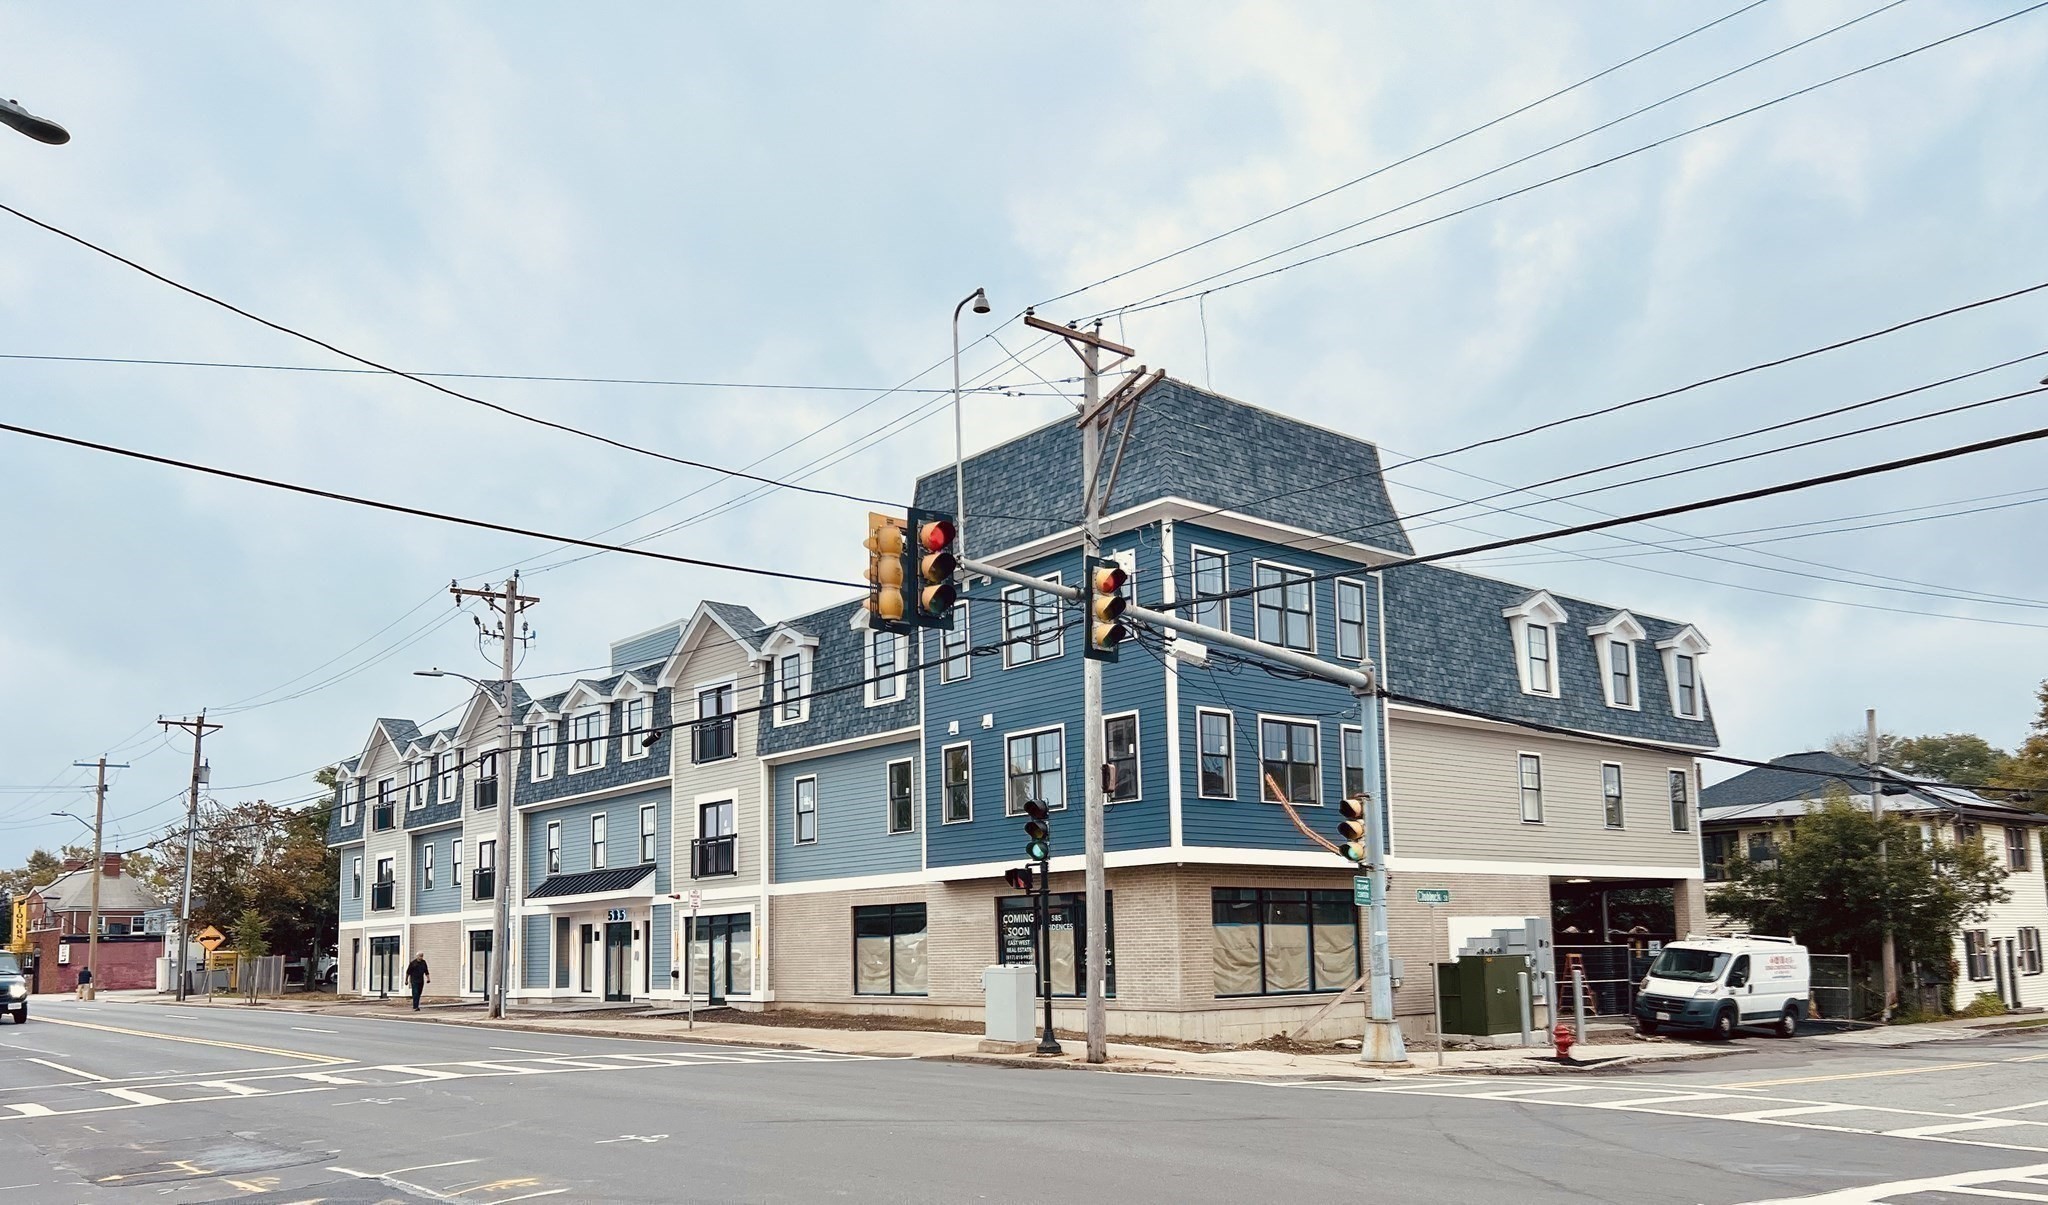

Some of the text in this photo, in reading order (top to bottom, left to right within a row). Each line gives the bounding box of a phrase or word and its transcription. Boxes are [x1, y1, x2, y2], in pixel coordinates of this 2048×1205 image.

[608, 909, 626, 922] 585
[1003, 913, 1034, 924] COMING
[1007, 926, 1030, 937] SOON
